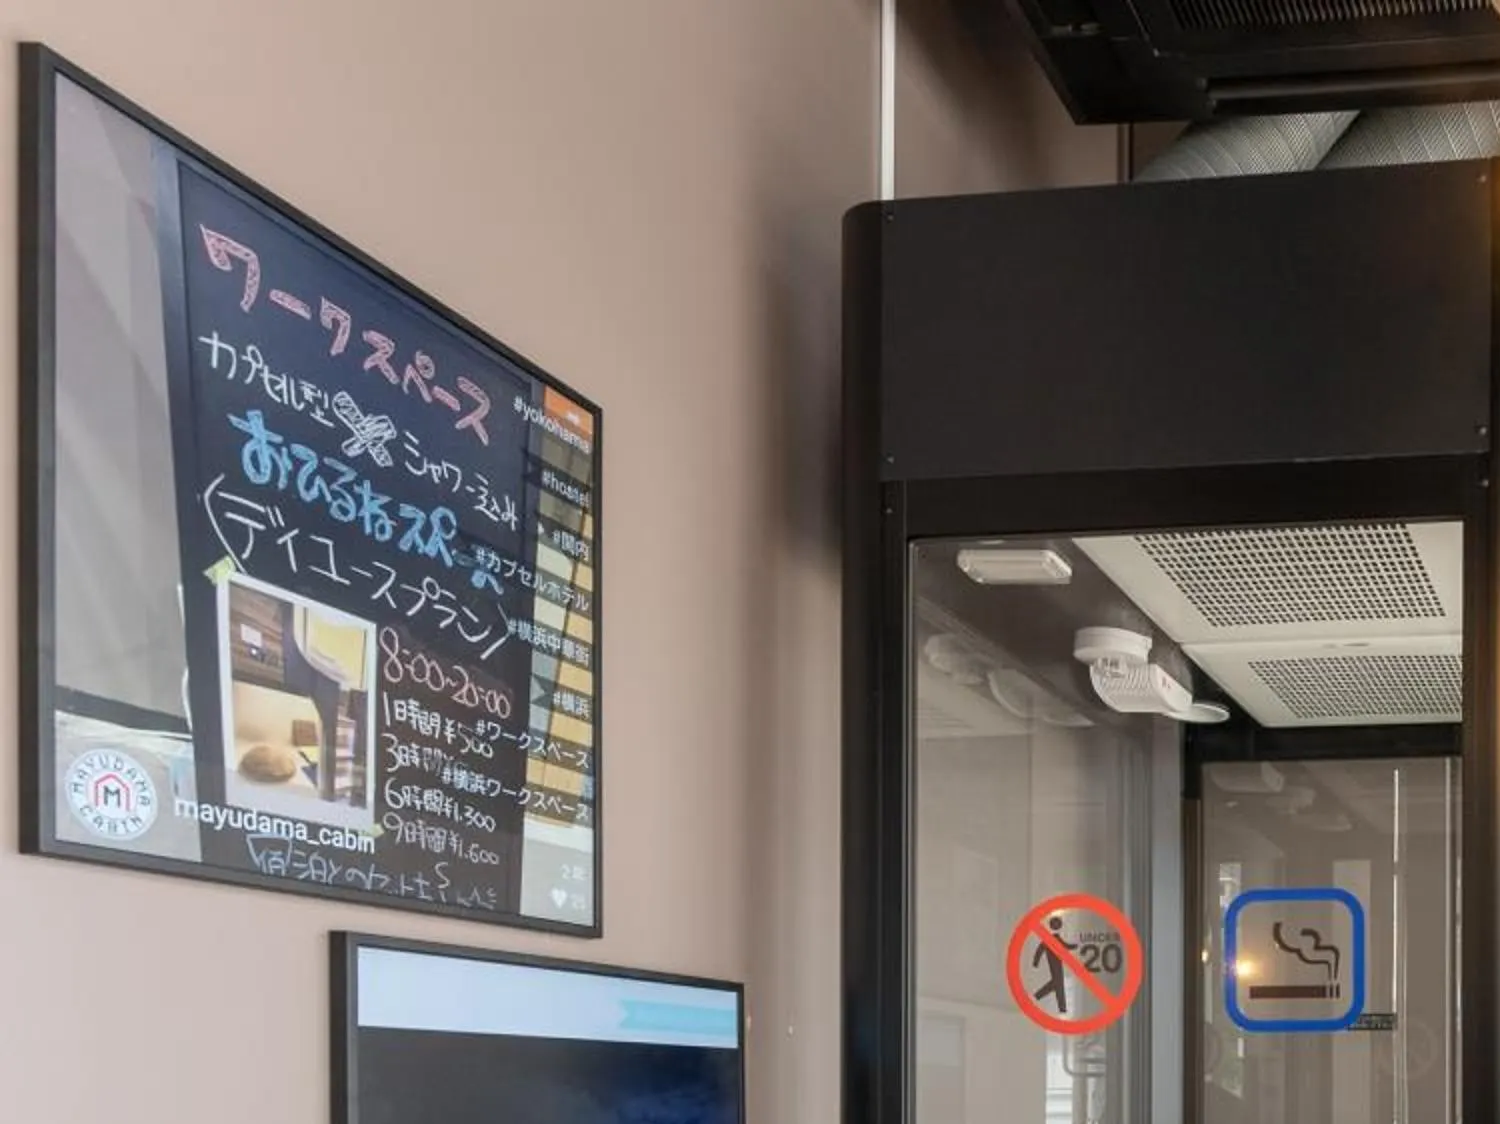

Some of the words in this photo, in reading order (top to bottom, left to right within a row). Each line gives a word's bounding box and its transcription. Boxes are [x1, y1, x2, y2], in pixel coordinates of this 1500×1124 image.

[513, 396, 592, 455] #yokohama
[475, 719, 590, 769] #ワークスペース
[72, 753, 151, 806] MAYUDAMA
[174, 798, 375, 854] mayudama_cabin
[1080, 943, 1123, 973] 20
